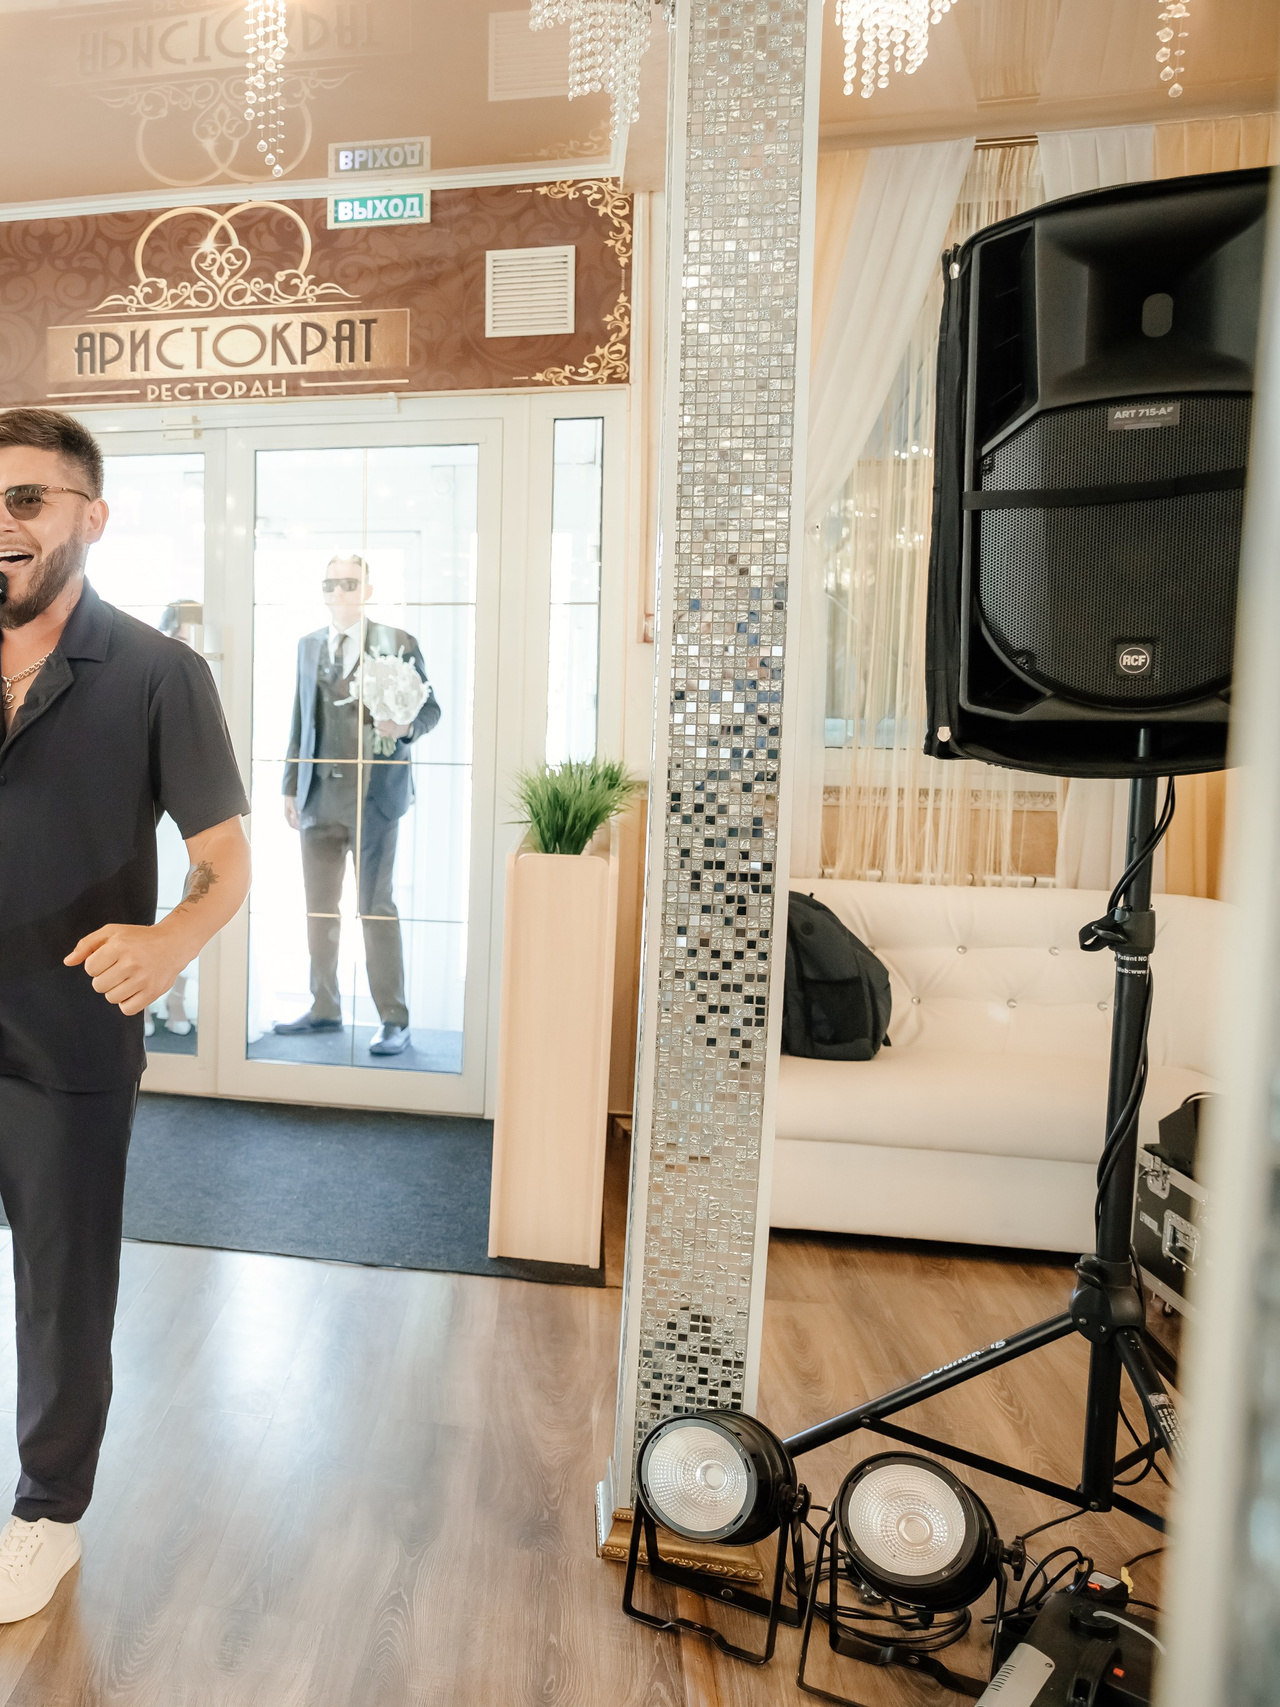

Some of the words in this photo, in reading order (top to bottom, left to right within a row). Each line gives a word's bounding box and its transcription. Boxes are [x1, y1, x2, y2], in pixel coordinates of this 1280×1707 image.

[337, 196, 421, 221] ВЫХОД
[73, 317, 379, 376] АРИСТОКРАТ
[146, 378, 288, 402] РЕСТОРАН
[1114, 409, 1137, 420] ART
[1138, 407, 1167, 417] 715-A
[1122, 654, 1147, 666] RCF
